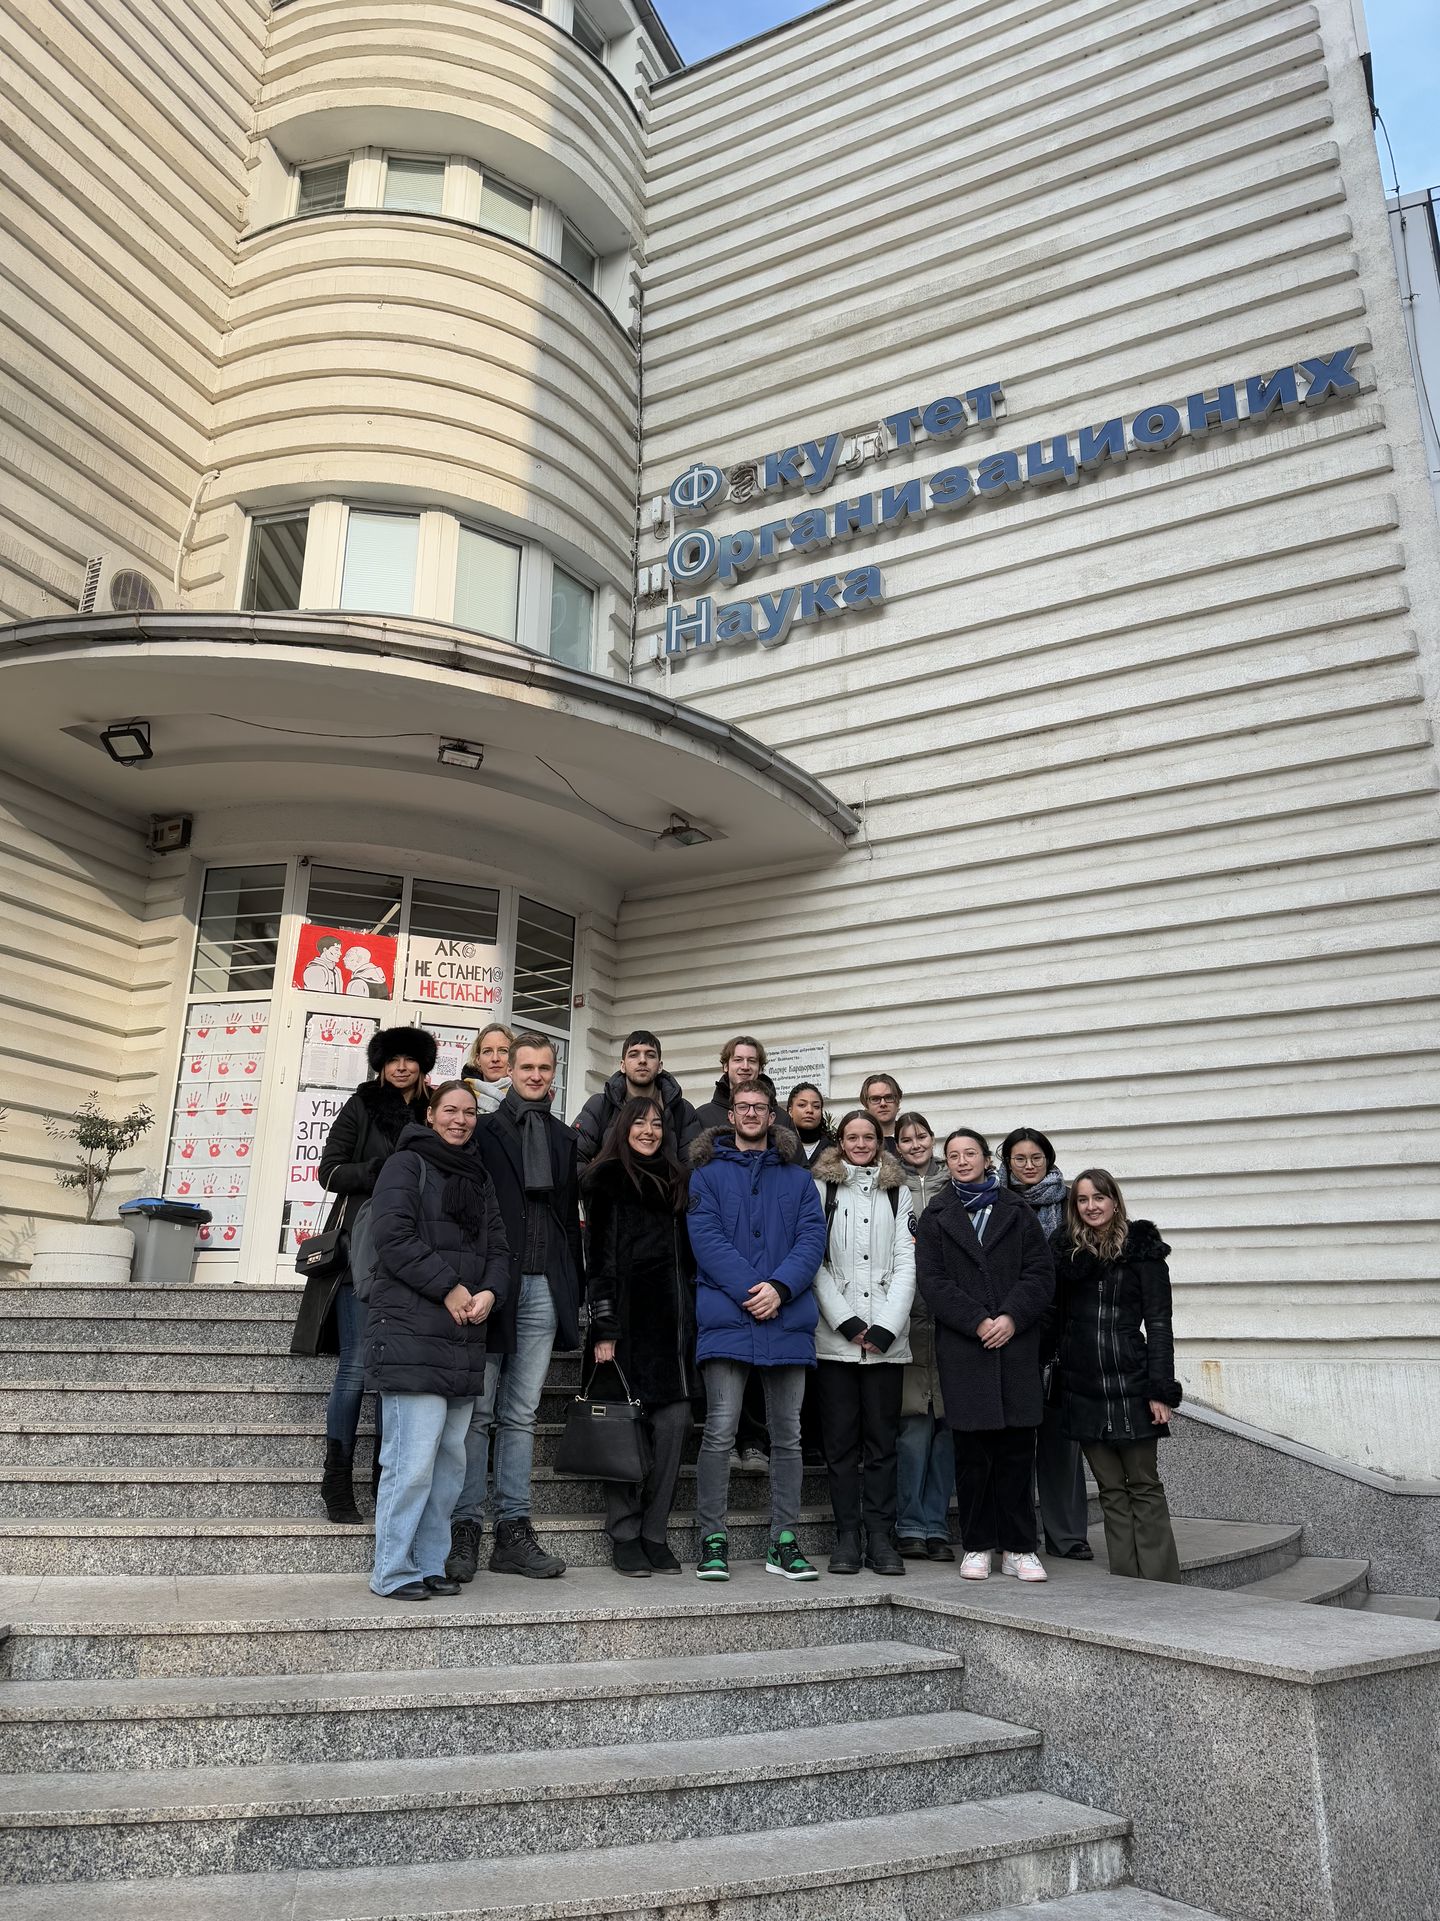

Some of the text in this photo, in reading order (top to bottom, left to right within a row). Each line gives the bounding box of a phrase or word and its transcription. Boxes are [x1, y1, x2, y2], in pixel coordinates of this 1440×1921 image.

[667, 346, 1359, 586] Организационих
[669, 382, 1004, 510] Факултет
[666, 565, 886, 655] Наука
[415, 960, 432, 977] НЕ
[296, 1145, 322, 1161] ПО
[297, 1121, 331, 1140] ЗГР
